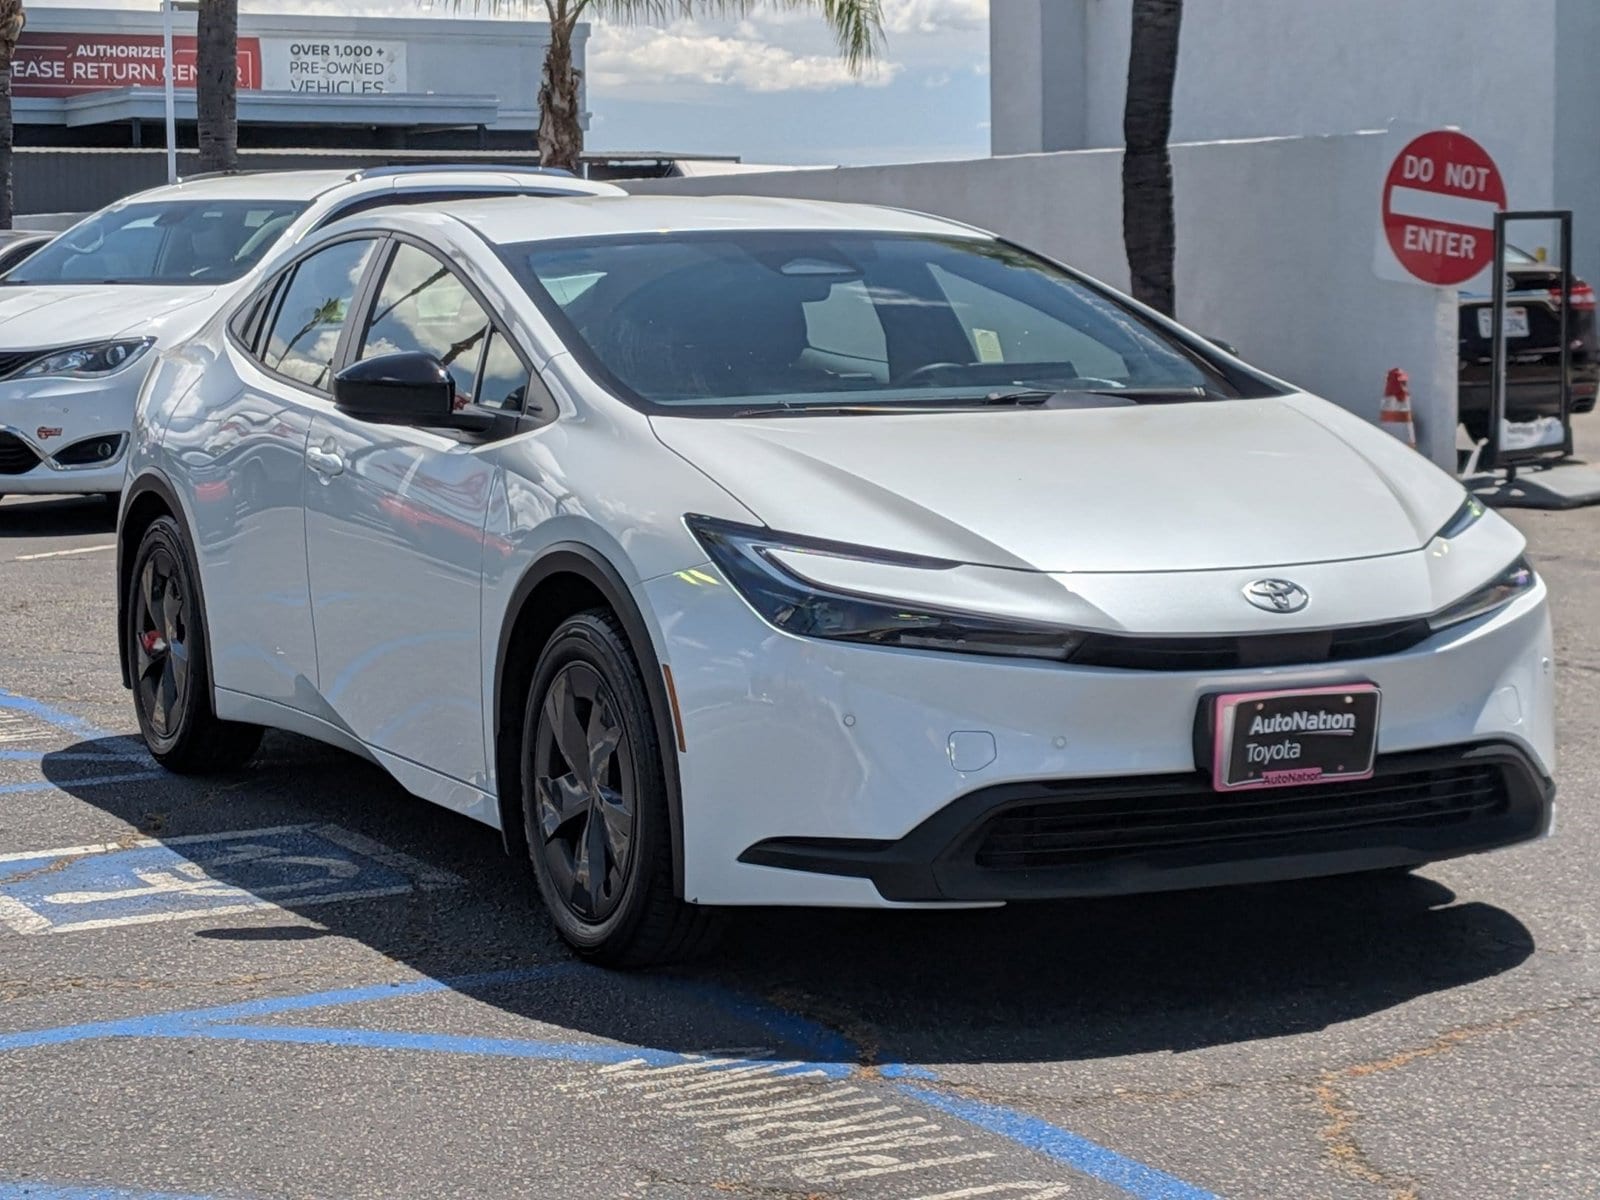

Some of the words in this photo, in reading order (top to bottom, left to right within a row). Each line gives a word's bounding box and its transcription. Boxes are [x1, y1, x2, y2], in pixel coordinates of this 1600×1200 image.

[290, 44, 330, 56] OVER
[334, 45, 373, 58] 1,000
[11, 61, 65, 78] EASE
[73, 62, 156, 80] RETURN
[162, 64, 242, 82] CENR
[290, 61, 384, 75] PRE-OWNED
[290, 80, 384, 93] VEHICLES
[1403, 155, 1434, 182] DO
[1445, 162, 1490, 192] NOT
[1404, 224, 1476, 259] ENTER
[1249, 710, 1355, 735] AutoNation
[1246, 739, 1301, 765] Toyota
[1263, 771, 1322, 785] AutoNation
